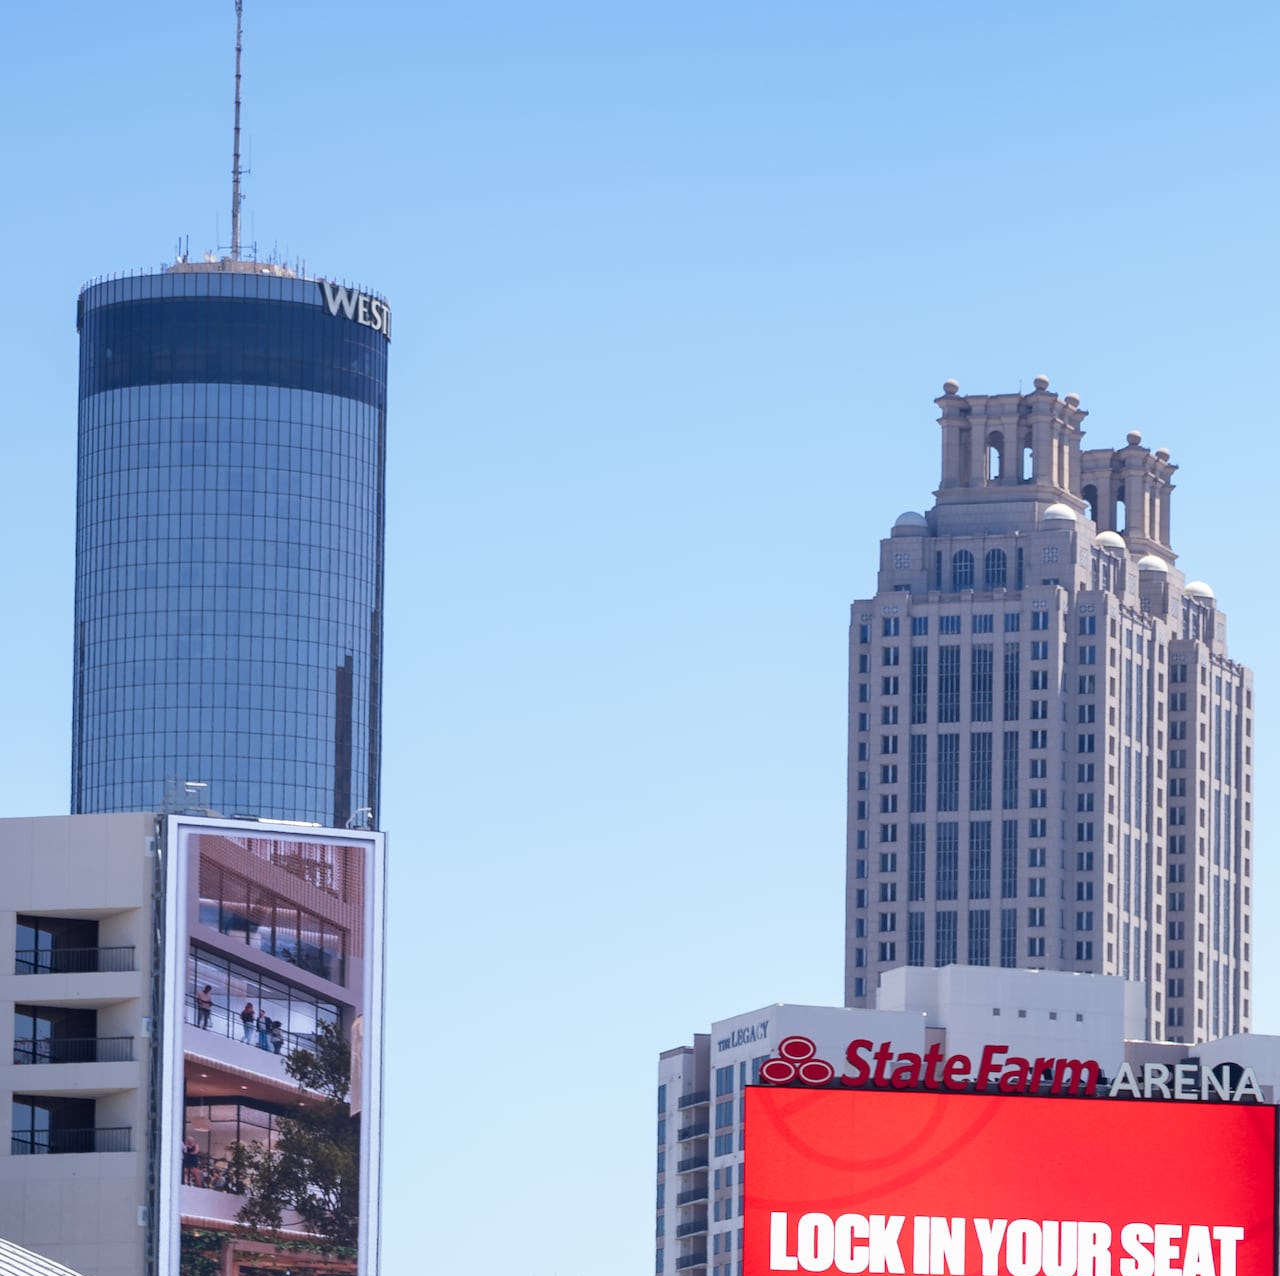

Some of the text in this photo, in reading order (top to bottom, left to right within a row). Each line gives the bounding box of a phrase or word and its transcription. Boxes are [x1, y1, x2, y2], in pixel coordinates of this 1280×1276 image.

[323, 282, 391, 338] WEST
[731, 1020, 769, 1048] LEGACY
[1109, 1061, 1265, 1103] ARENA
[769, 1211, 905, 1275] LOCK
[913, 1215, 966, 1276] IN
